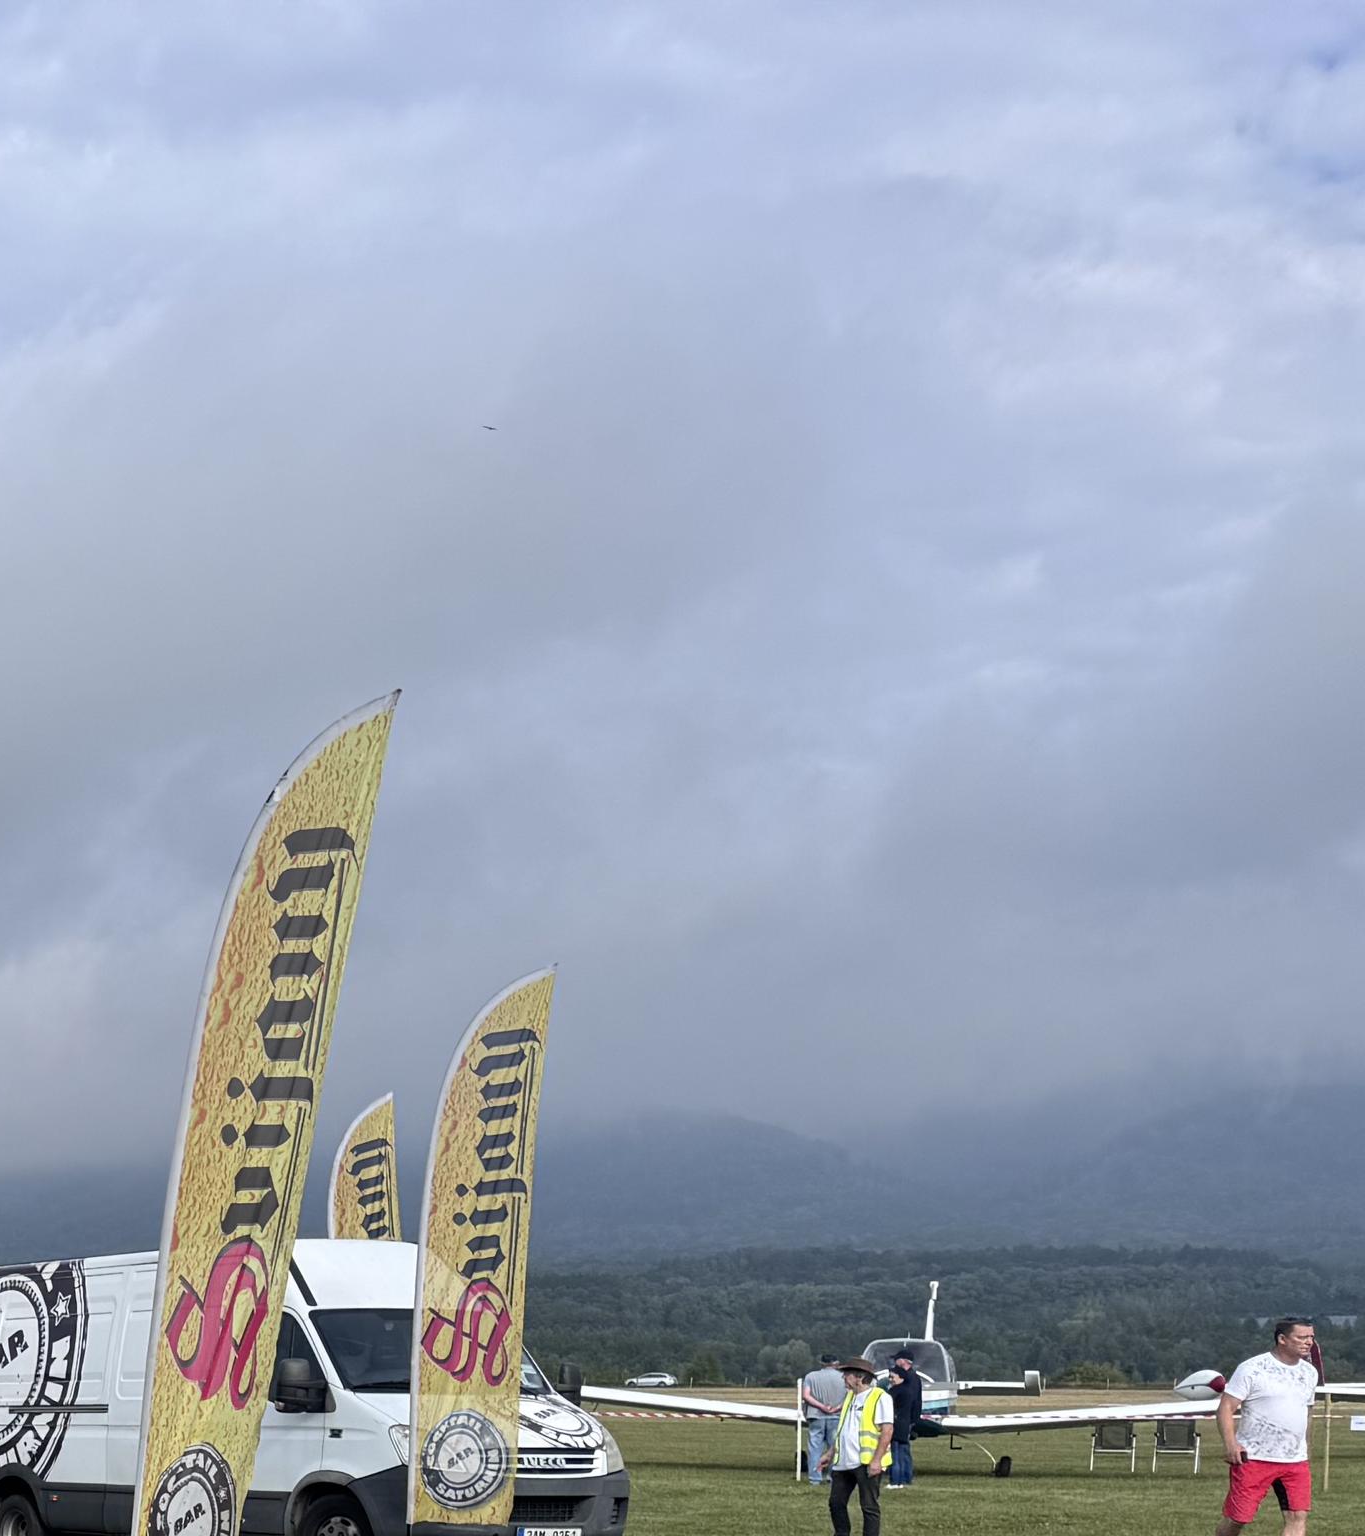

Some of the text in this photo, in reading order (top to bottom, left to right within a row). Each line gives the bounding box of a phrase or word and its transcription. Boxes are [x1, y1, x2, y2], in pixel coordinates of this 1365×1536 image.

[168, 827, 359, 1410] Svijany
[420, 1028, 542, 1388] Svijany
[173, 1503, 206, 1536] BAR
[523, 1457, 566, 1468] IVECO
